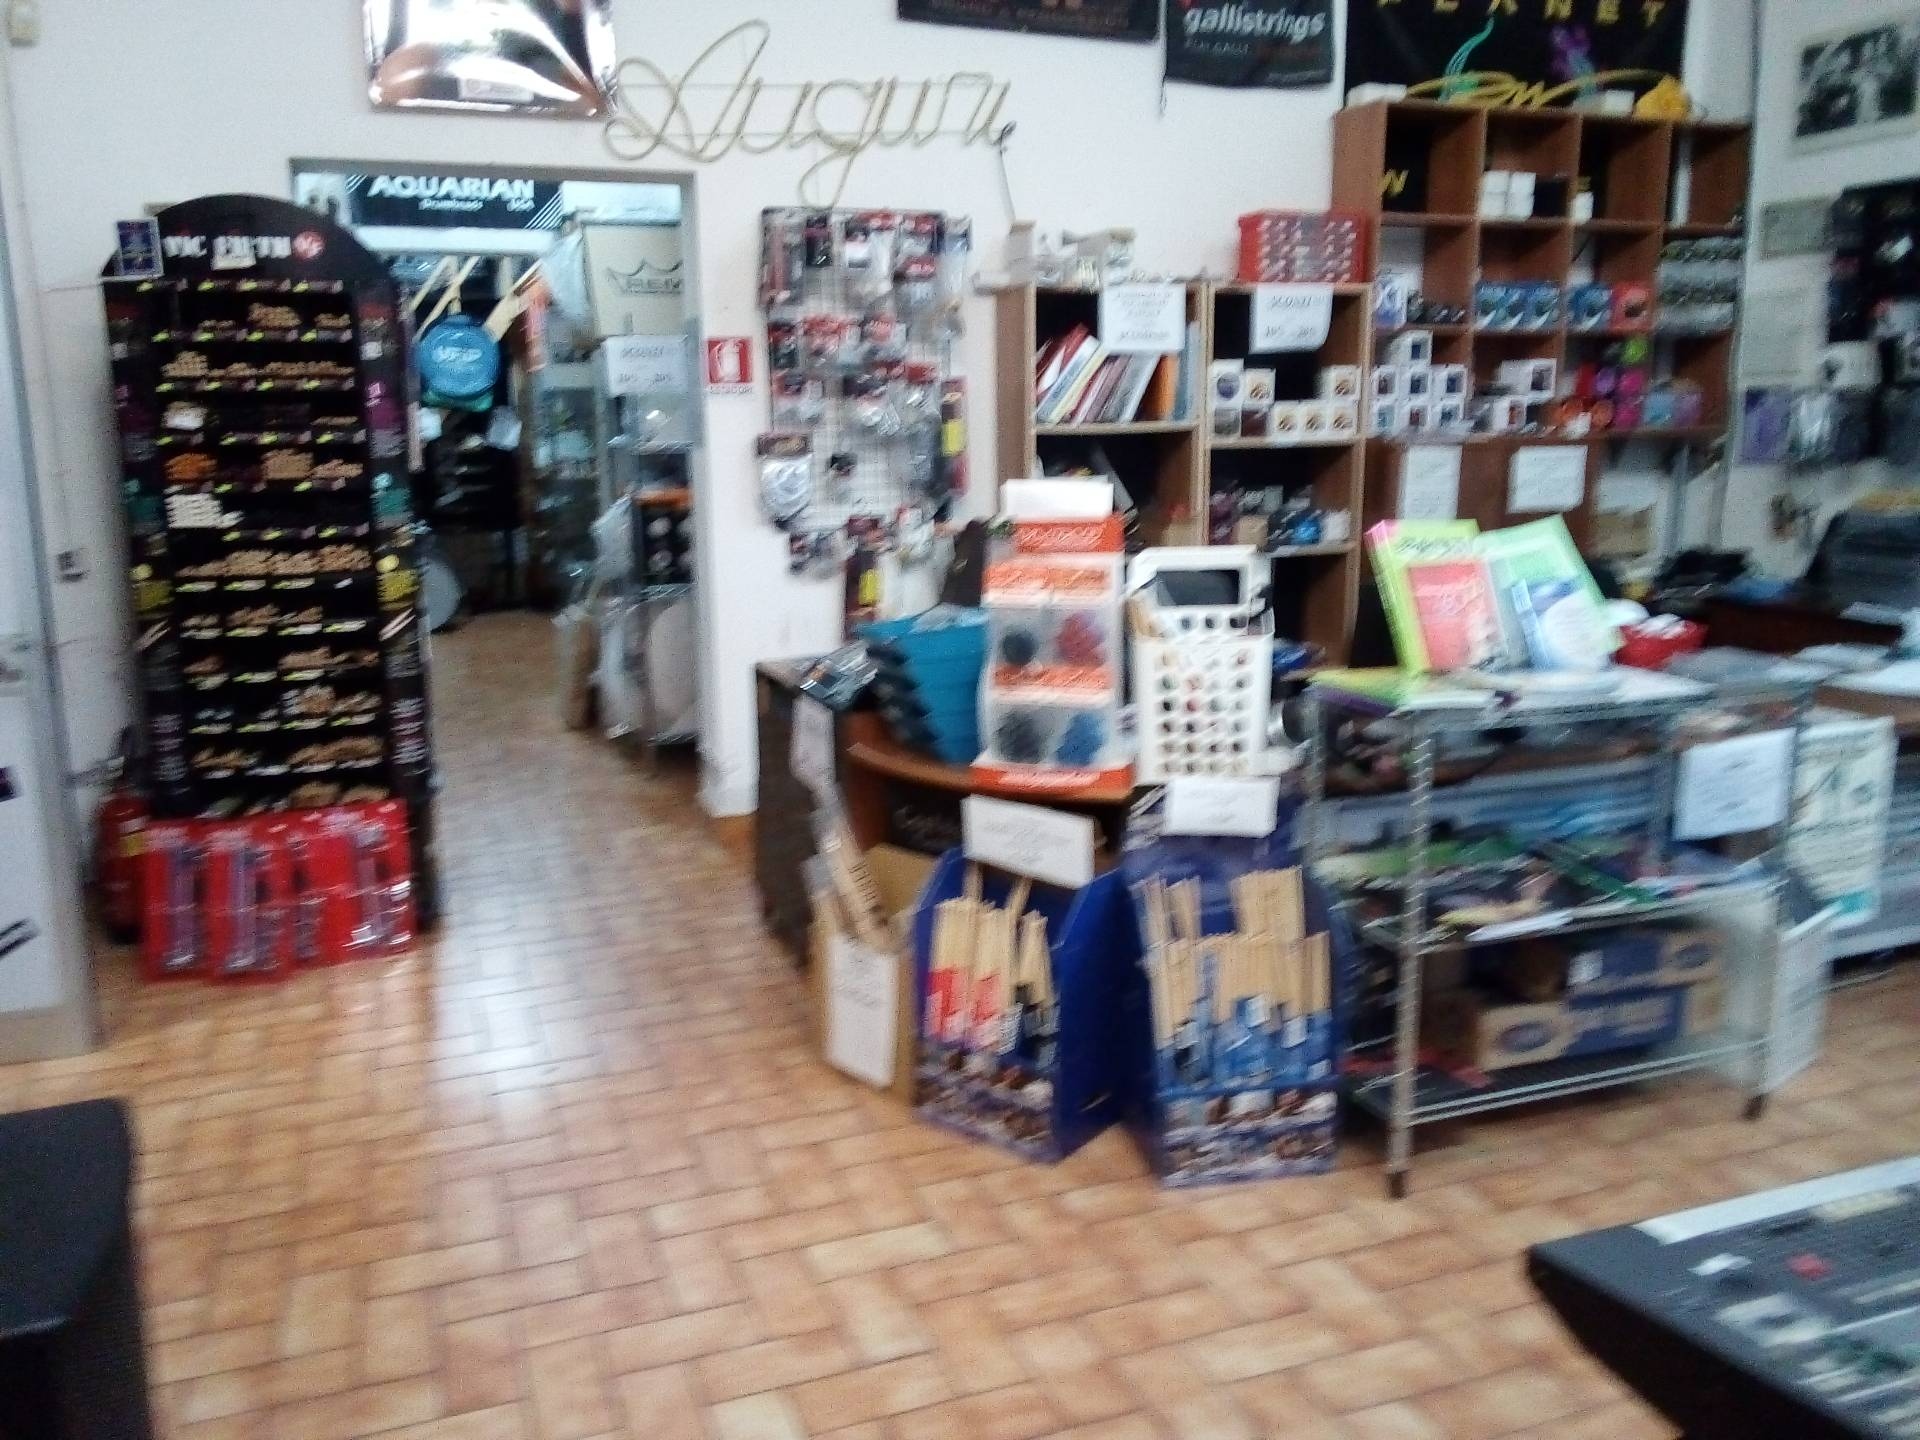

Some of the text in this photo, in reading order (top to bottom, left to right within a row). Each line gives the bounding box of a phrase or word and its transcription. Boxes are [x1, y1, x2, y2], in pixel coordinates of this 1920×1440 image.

[1182, 3, 1327, 45] gallistrings
[602, 18, 1012, 208] Auguri
[367, 174, 536, 200] AQUARIAN
